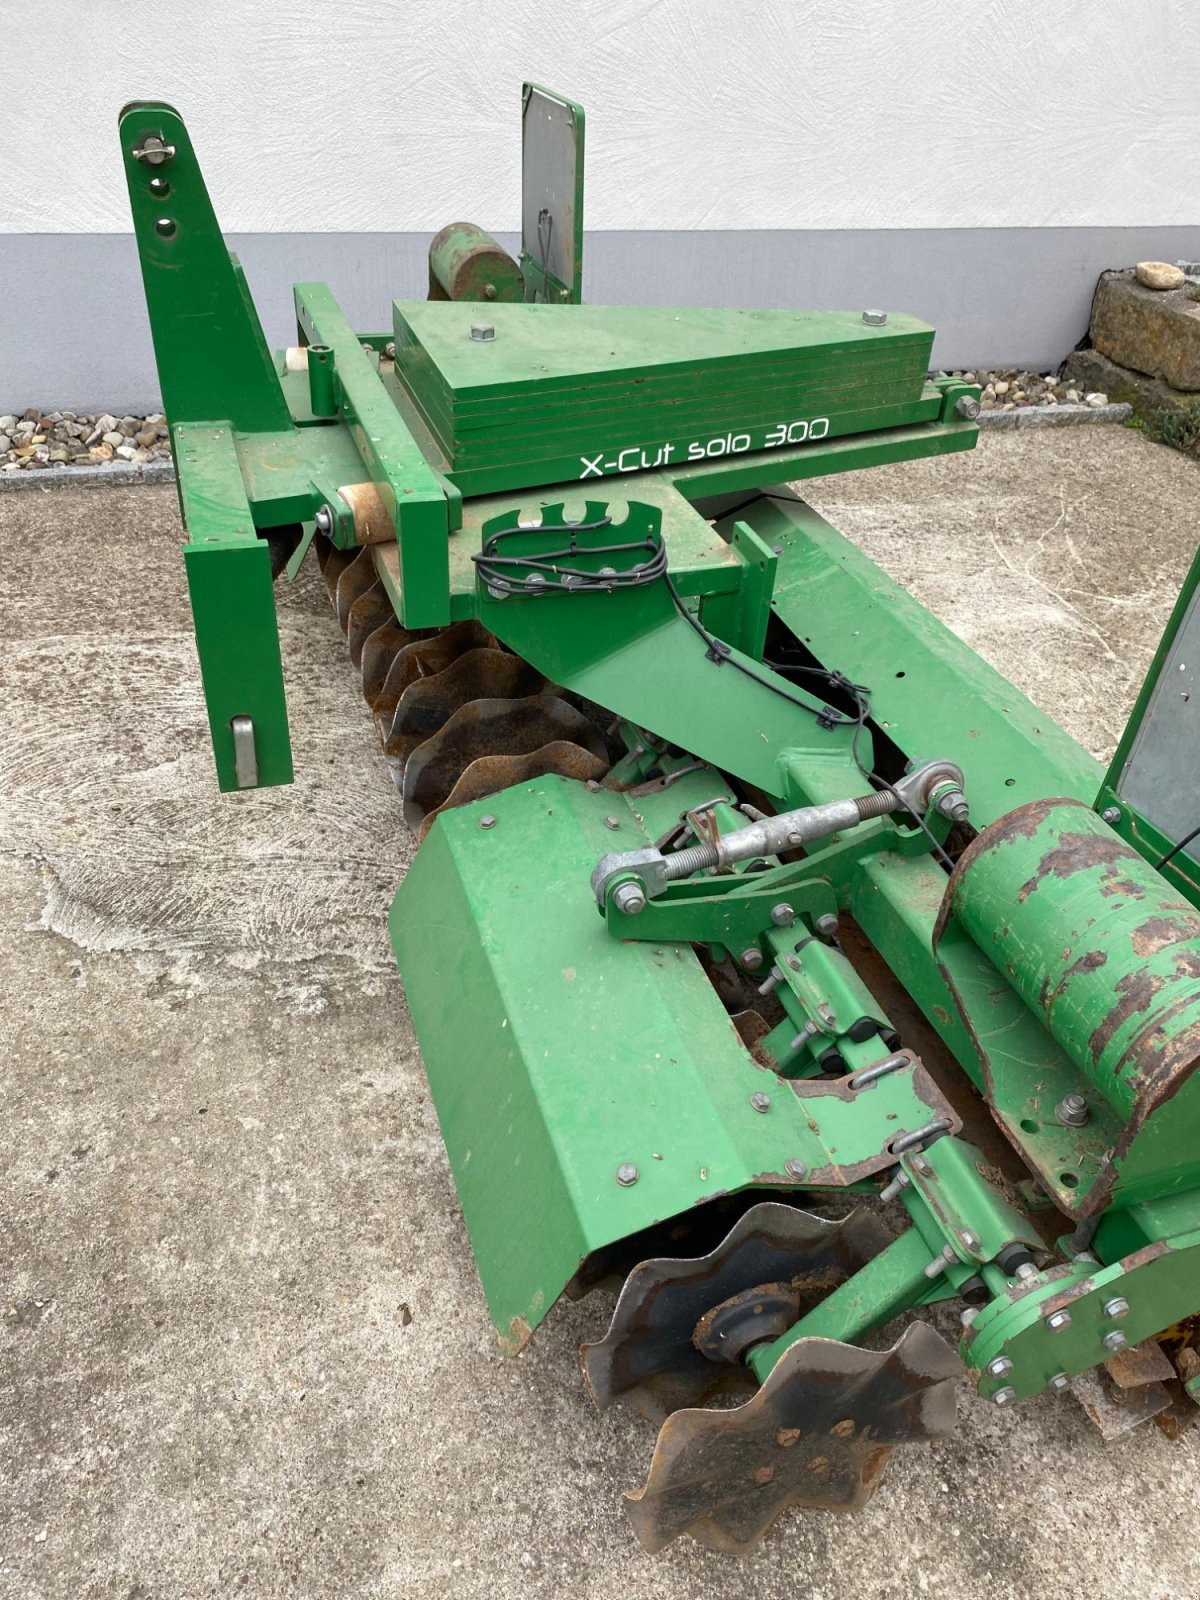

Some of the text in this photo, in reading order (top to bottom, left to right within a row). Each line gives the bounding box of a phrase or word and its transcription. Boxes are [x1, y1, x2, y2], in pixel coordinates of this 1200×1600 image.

[579, 417, 830, 479] X-Cut solo 300
